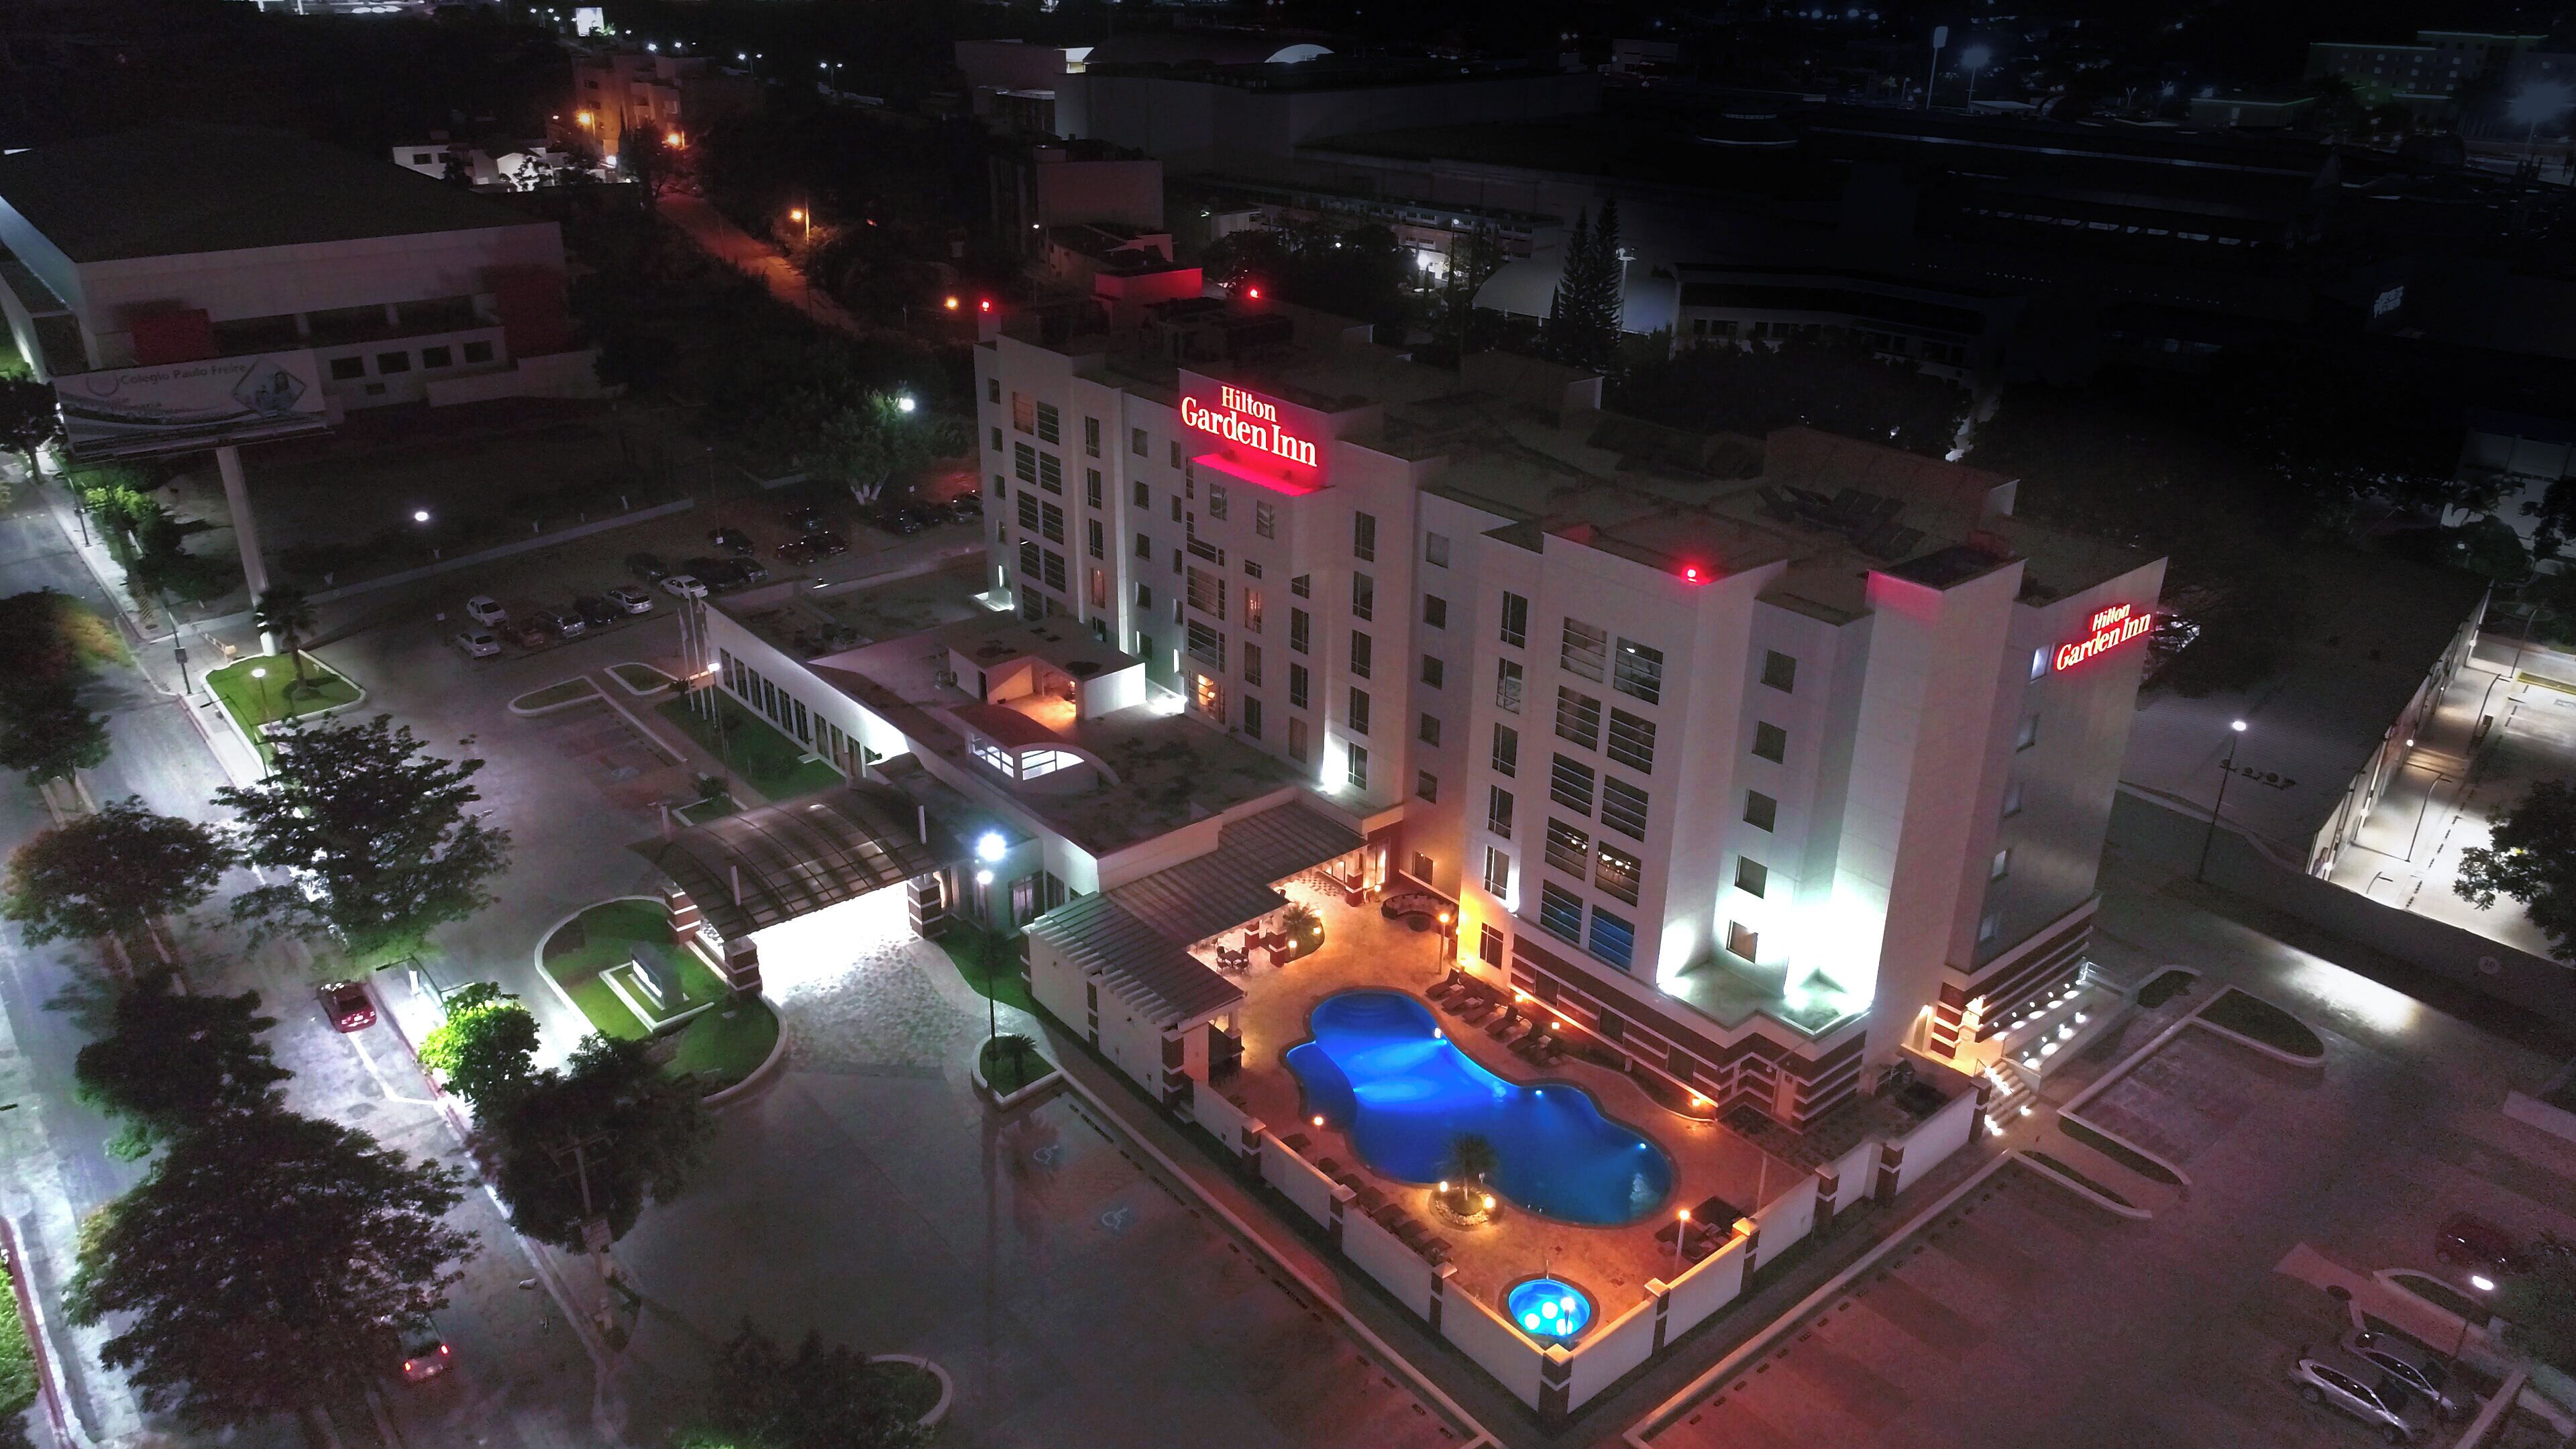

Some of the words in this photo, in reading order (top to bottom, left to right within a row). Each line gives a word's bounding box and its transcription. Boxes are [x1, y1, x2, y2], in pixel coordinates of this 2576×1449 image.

[121, 371, 170, 385] Colegio
[172, 368, 207, 378] Paulo
[211, 364, 246, 376] Freire
[1221, 386, 1277, 422] Hilton
[1181, 396, 1268, 451] Garden
[1271, 424, 1317, 467] Inn
[2092, 604, 2131, 631] Hilton
[2056, 627, 2121, 670] Garden
[2121, 614, 2151, 642] Inn
